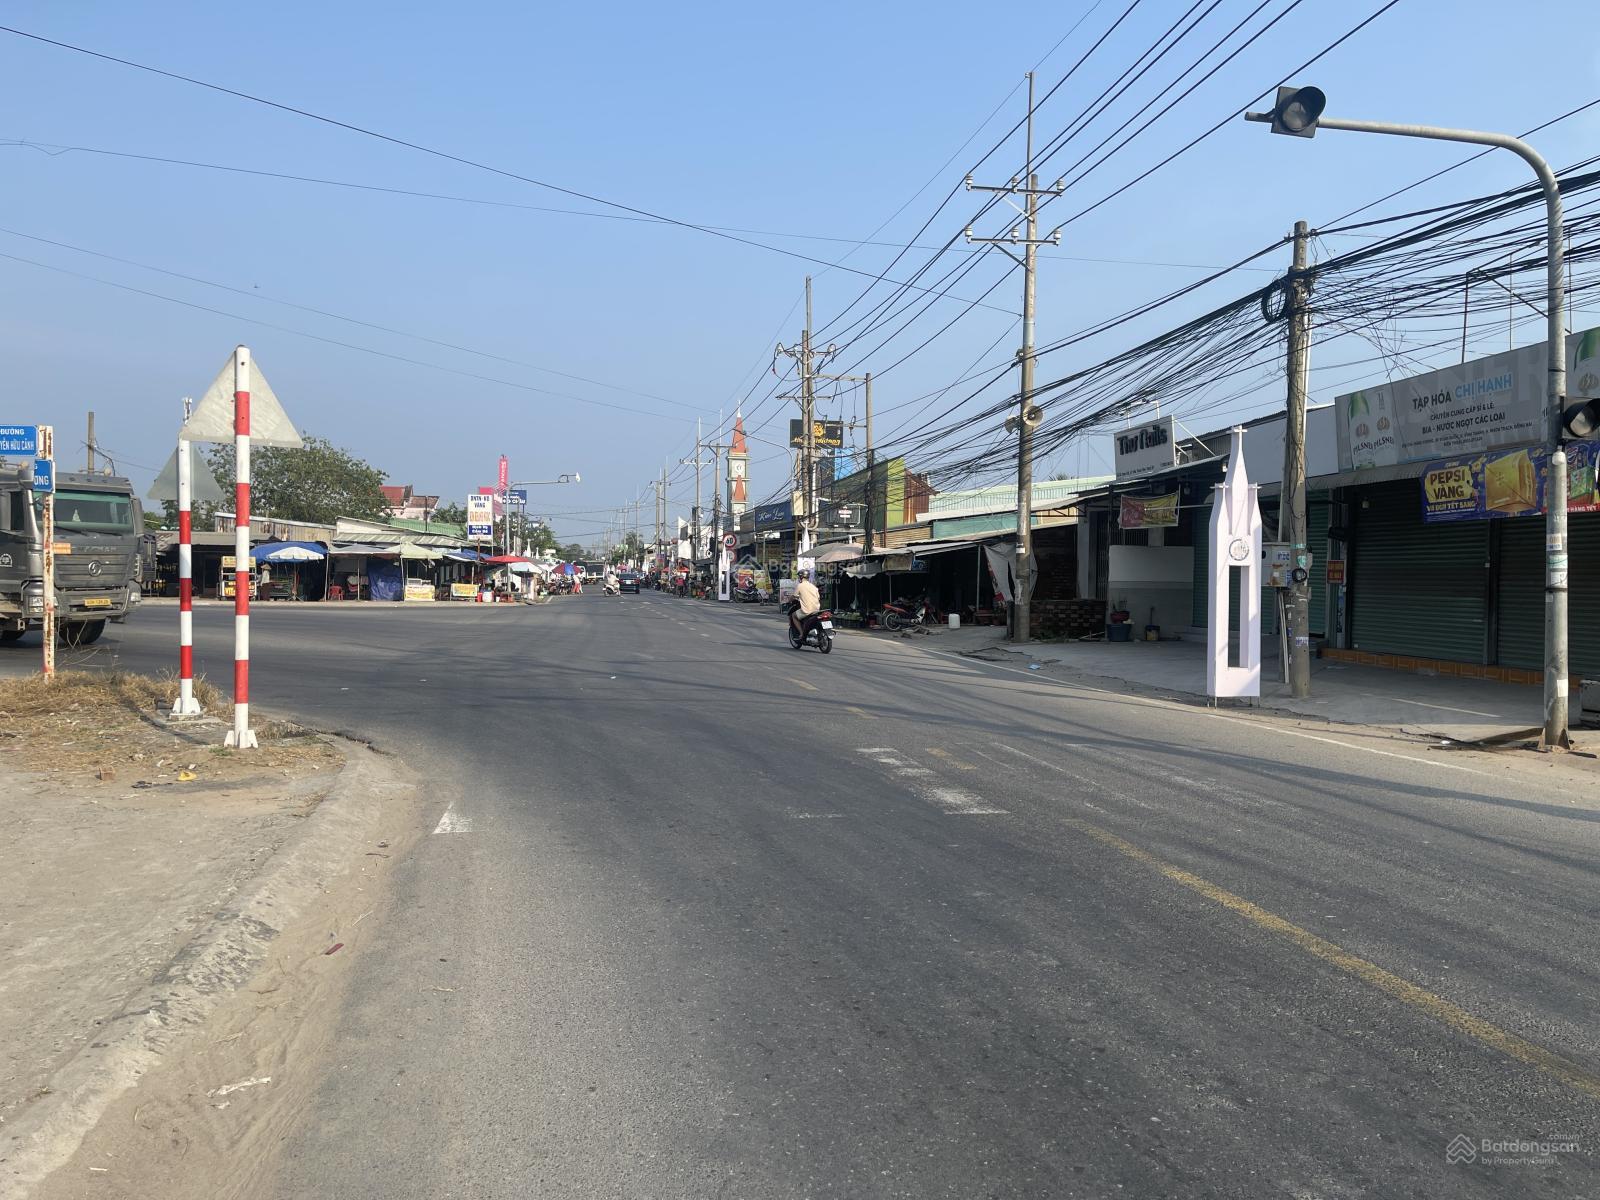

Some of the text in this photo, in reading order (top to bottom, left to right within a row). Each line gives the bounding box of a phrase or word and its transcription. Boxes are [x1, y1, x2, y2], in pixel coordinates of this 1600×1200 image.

[1412, 373, 1512, 414] TẠP HÓA CHỊ HẠNH
[1430, 410, 1450, 421] CHUYÊN
[1450, 408, 1465, 417] CUNG
[1422, 426, 1432, 435] BIA
[1436, 420, 1454, 433] NƯỚC
[1456, 418, 1473, 430] NGỌT
[1475, 413, 1489, 424] CÁC
[1490, 411, 1505, 423] LOẠI
[1430, 469, 1466, 485] PEPSI
[1433, 484, 1465, 500] VÀNG
